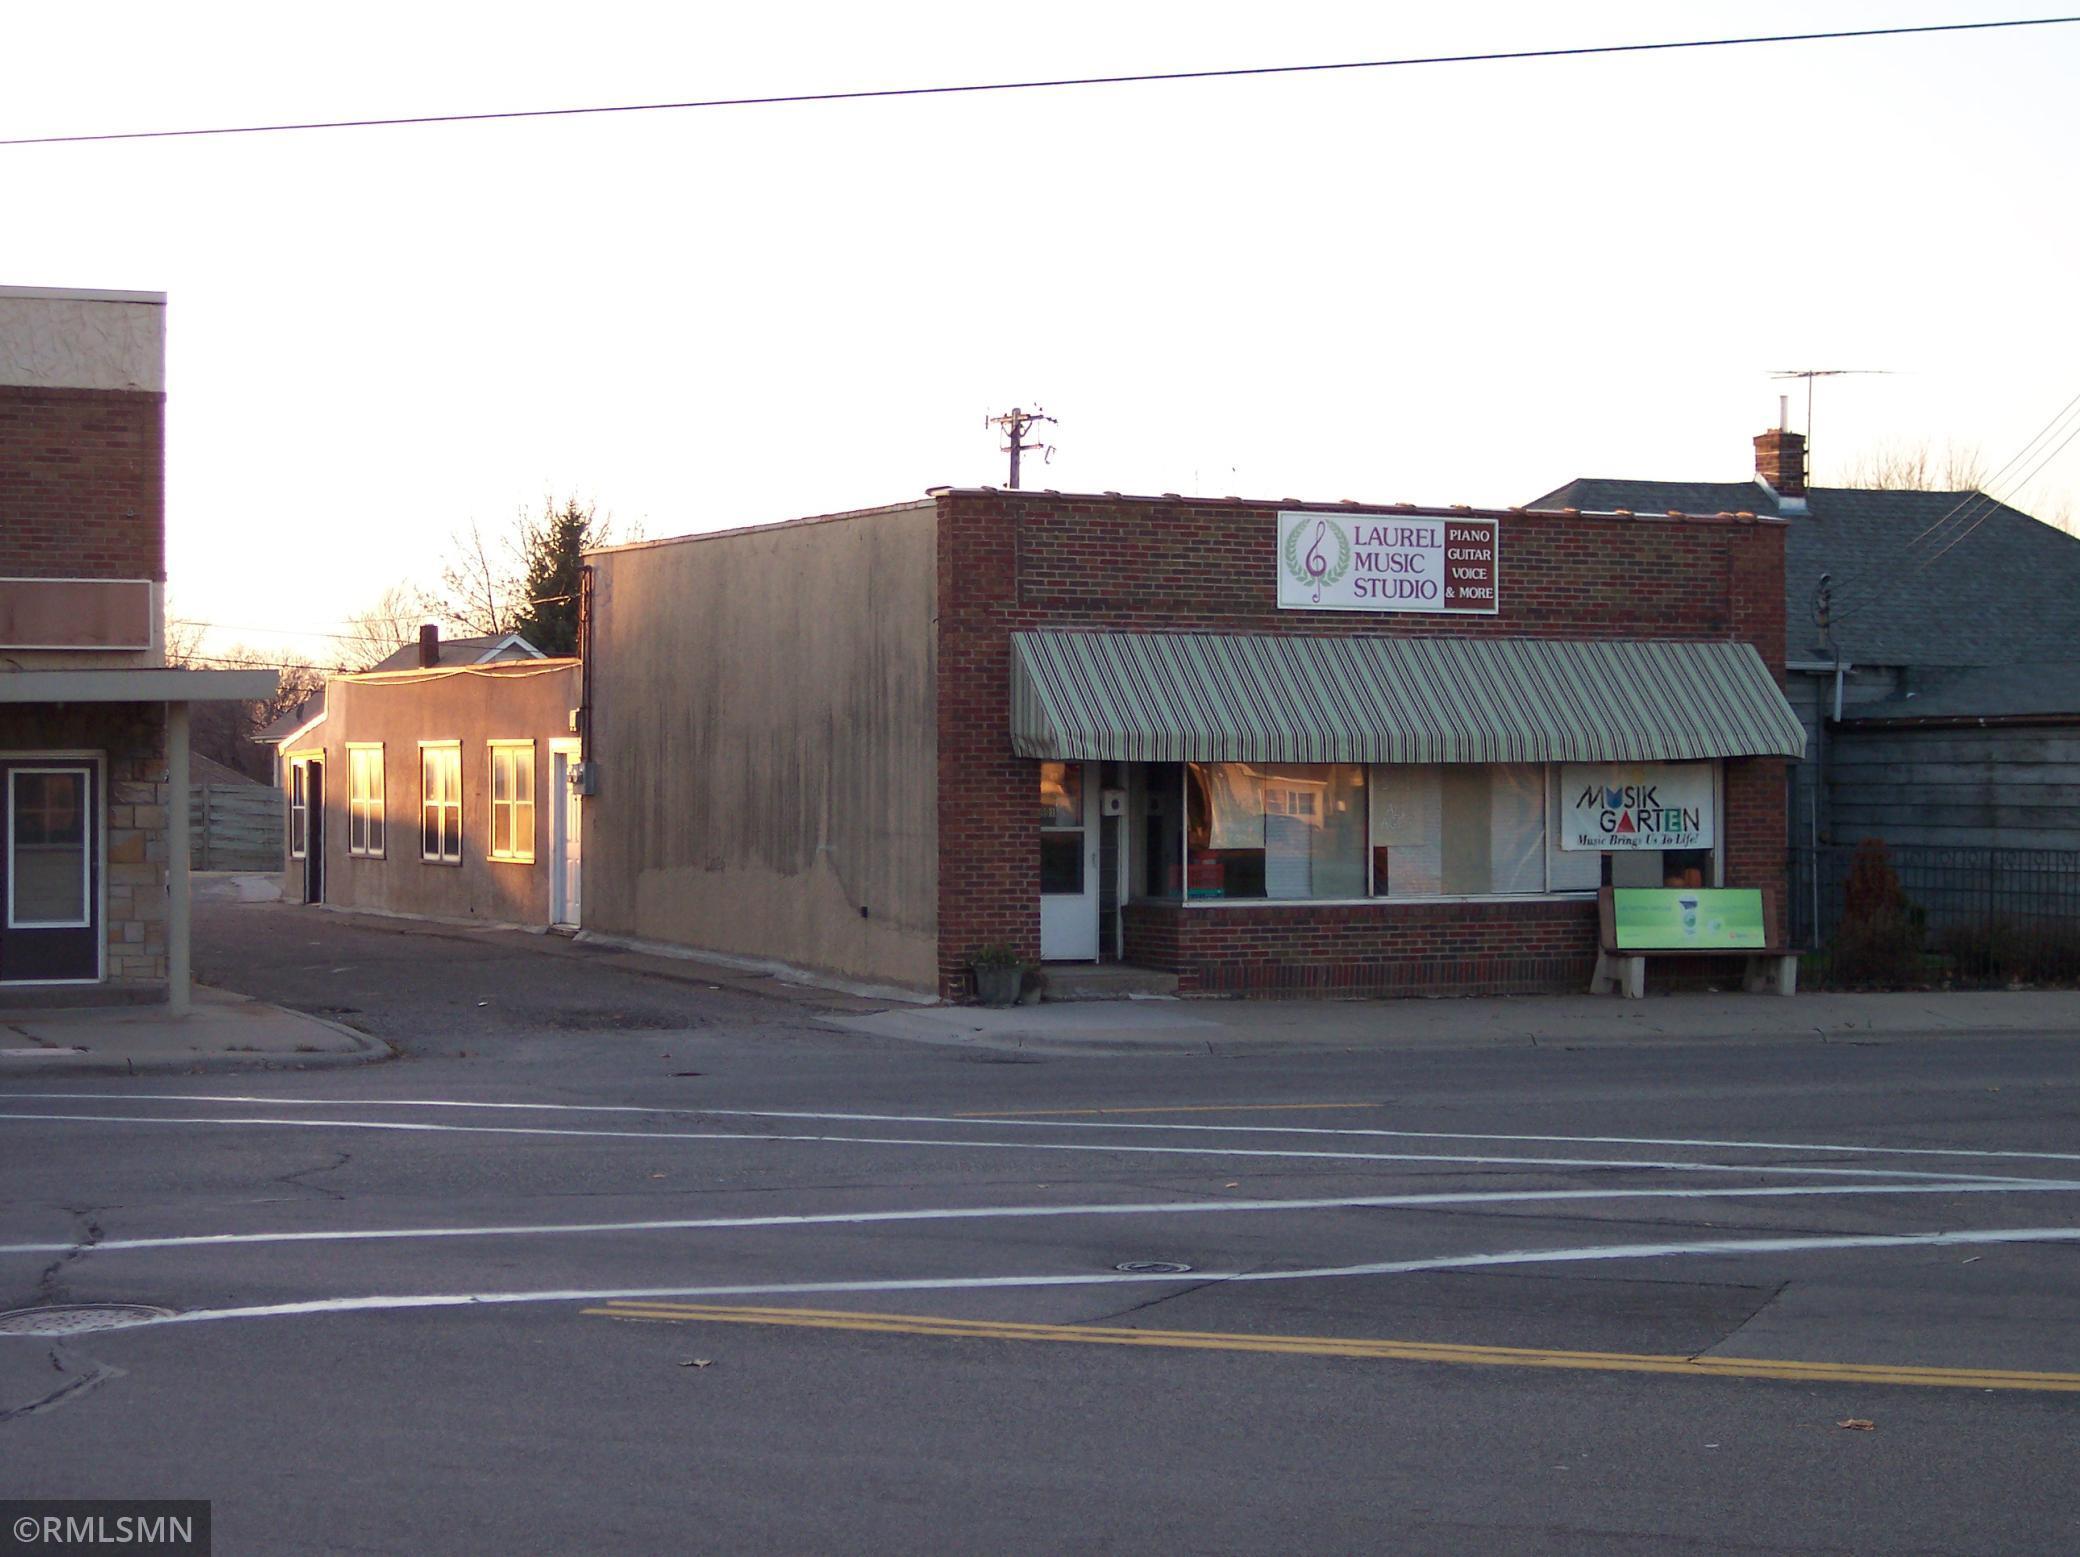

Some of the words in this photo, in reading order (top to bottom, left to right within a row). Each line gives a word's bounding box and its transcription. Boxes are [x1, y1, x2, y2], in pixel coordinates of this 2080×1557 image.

[1354, 526, 1442, 549] LAUREL
[1449, 529, 1490, 543] PIANO
[1354, 552, 1425, 574] MUSIC
[1447, 548, 1492, 561] GUITAR
[1452, 567, 1488, 580] VOICE
[1353, 578, 1438, 600] STUDIO
[1446, 587, 1455, 598] &
[1459, 587, 1494, 599] MORE
[1576, 784, 1661, 809] MUSIK
[1600, 808, 1700, 833] GARTEN
[1578, 834, 1606, 846] Music
[1661, 834, 1672, 845] To
